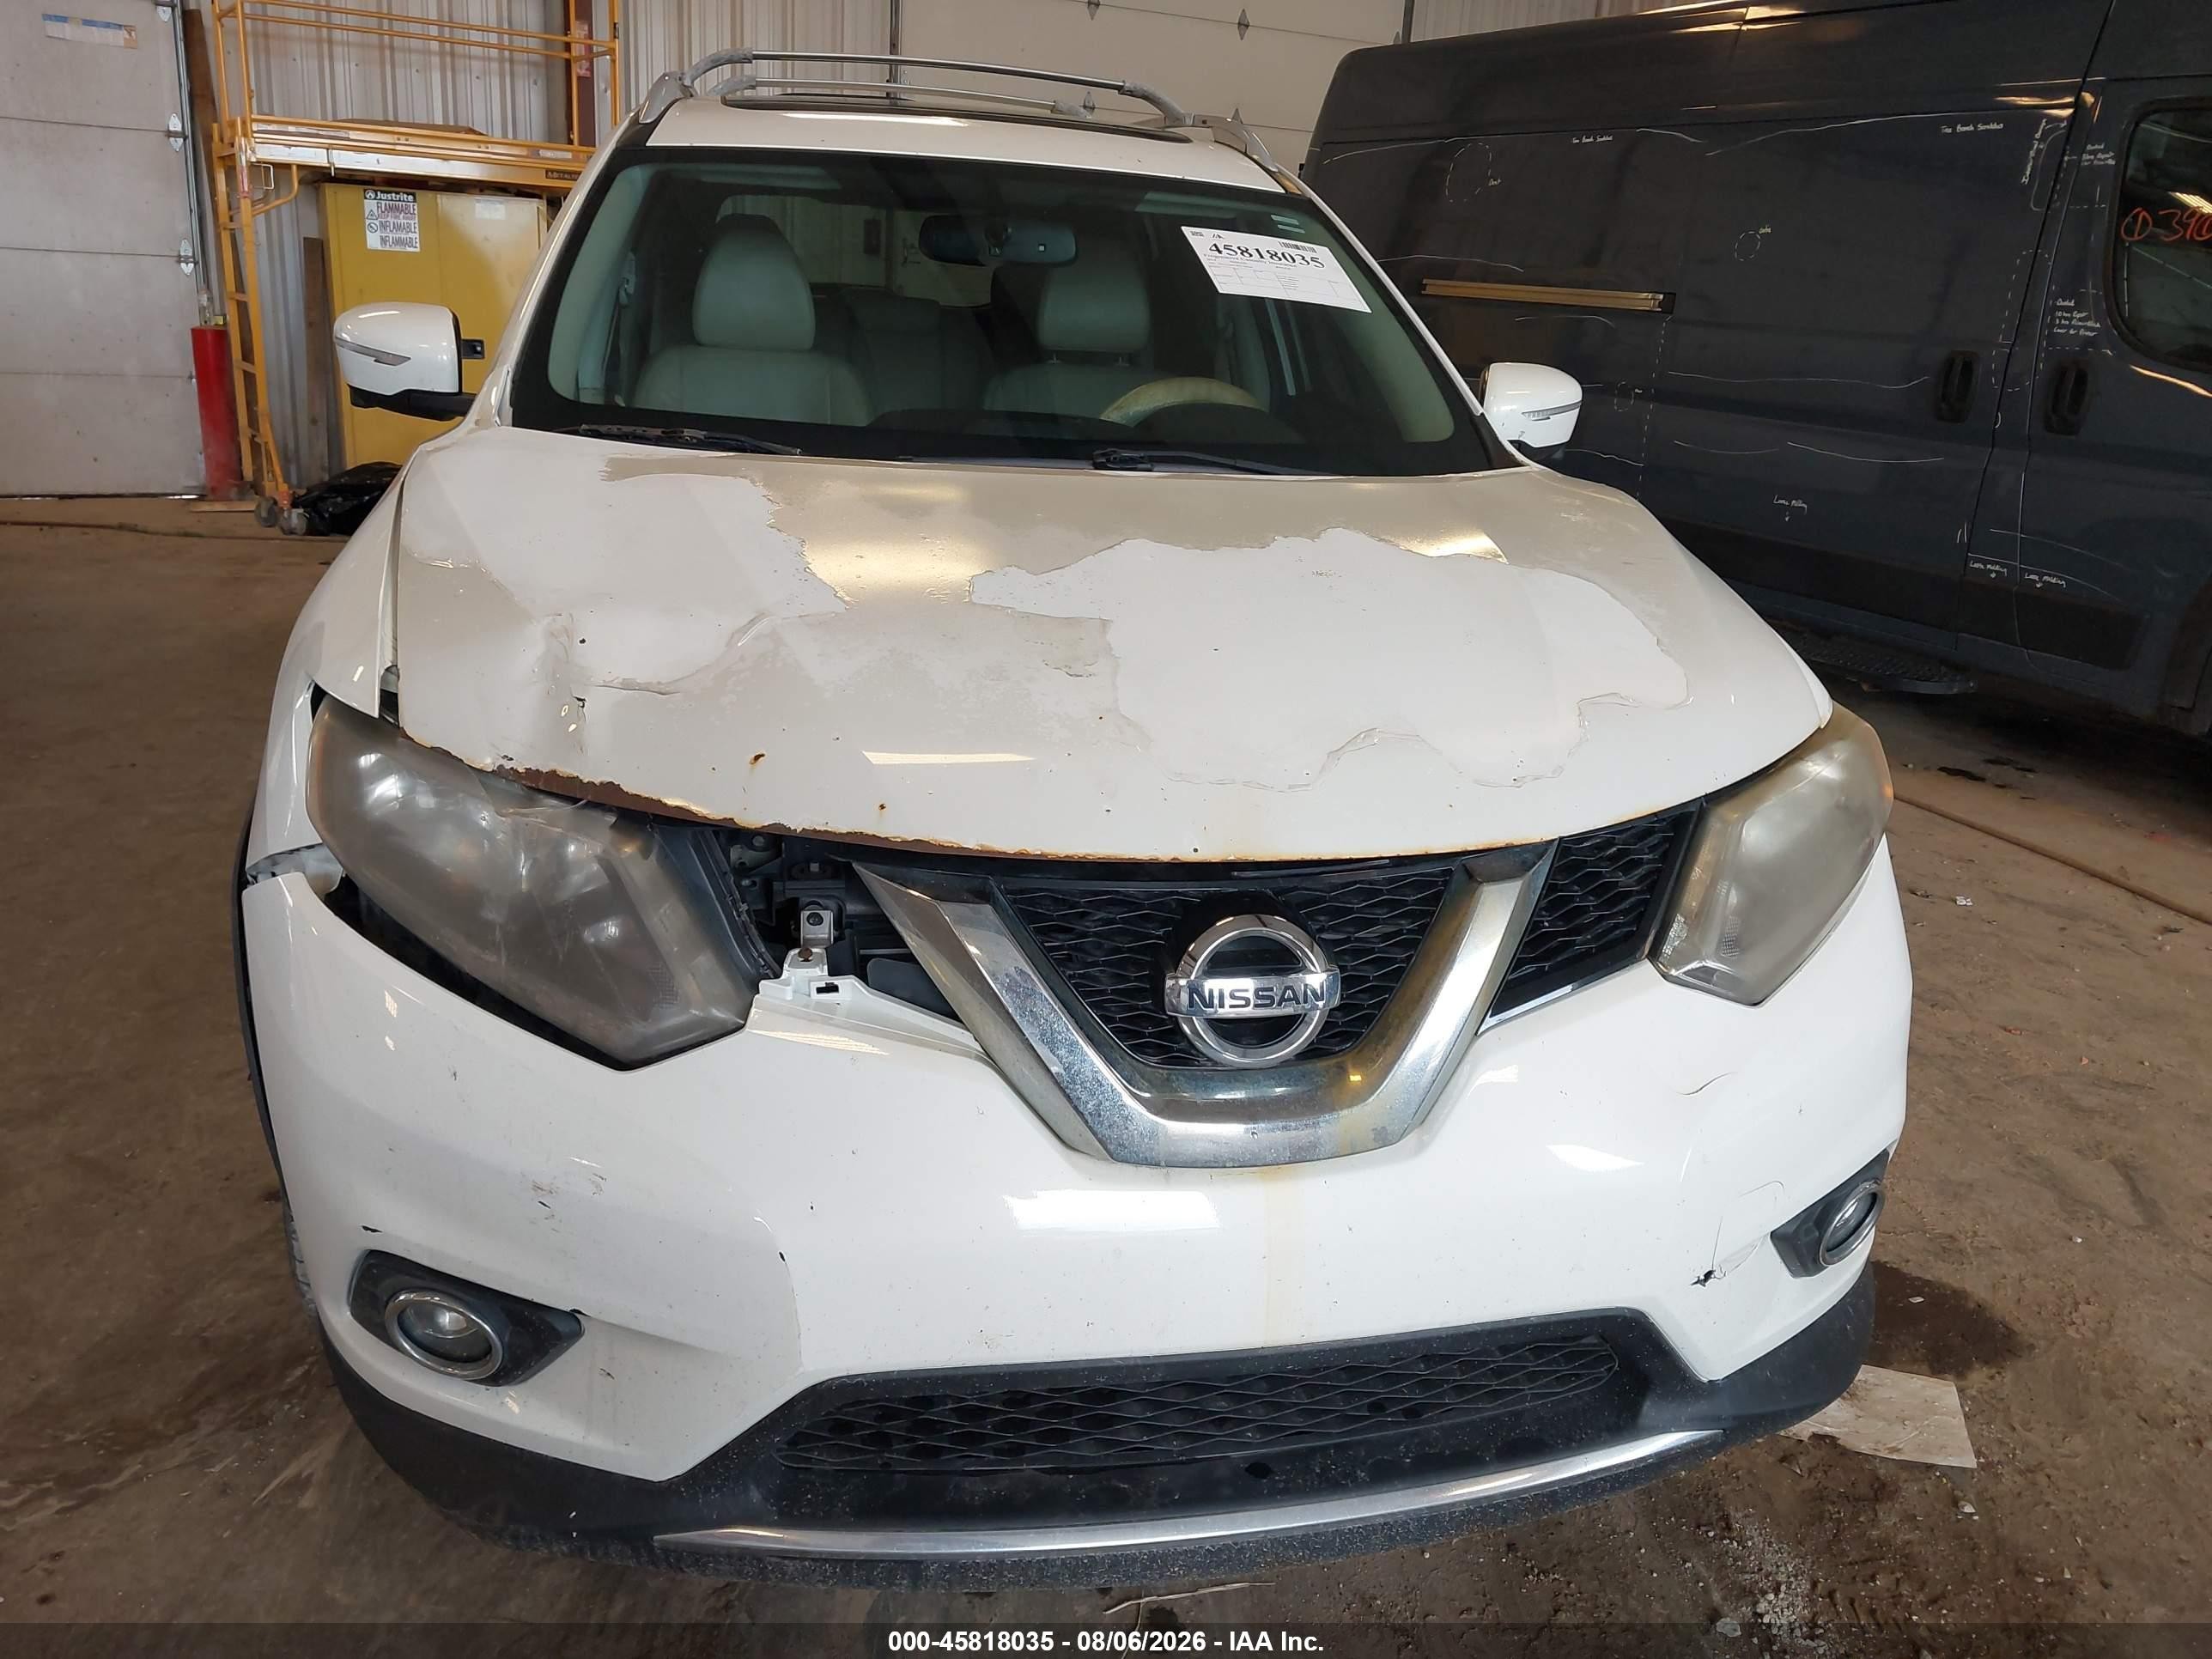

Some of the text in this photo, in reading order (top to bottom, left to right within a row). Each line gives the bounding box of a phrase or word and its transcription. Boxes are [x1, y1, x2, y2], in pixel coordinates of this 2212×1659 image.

[376, 191, 414, 202] Justrite
[376, 201, 416, 216] FLAMMABLE
[379, 220, 417, 234] INFLAMABLE
[379, 234, 419, 249] INFLAMMABLE
[1209, 243, 1325, 269] 45818035
[1187, 984, 1326, 1011] NISSAN
